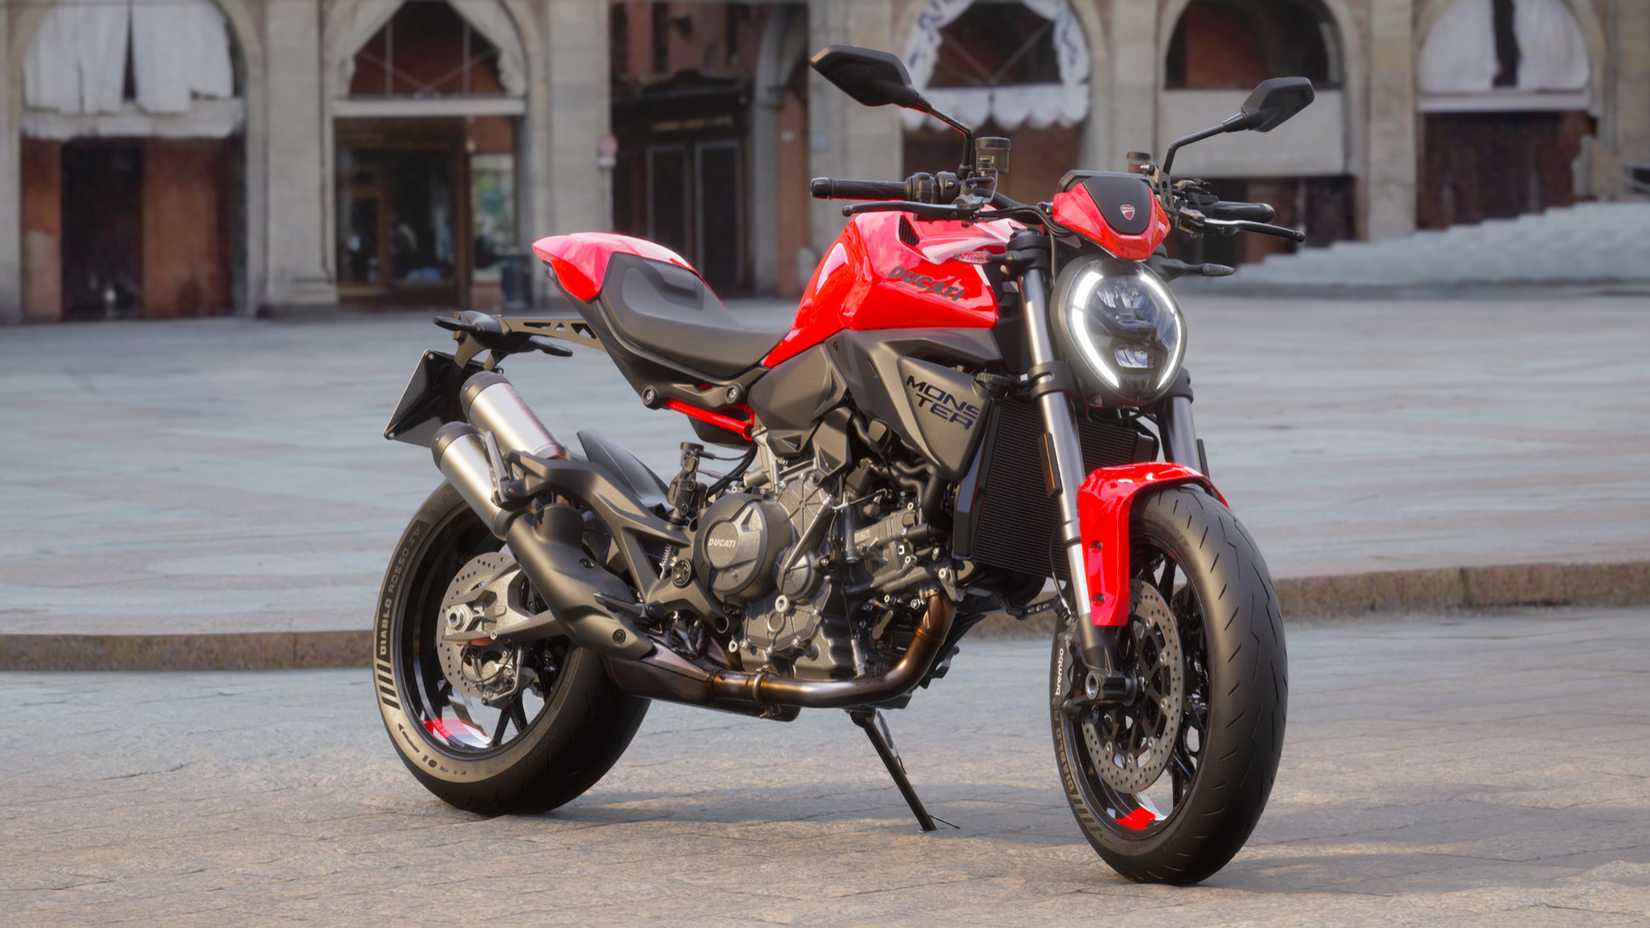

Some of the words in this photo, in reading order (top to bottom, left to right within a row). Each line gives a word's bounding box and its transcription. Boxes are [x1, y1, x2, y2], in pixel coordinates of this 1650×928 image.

[888, 265, 964, 301] DUCATI
[906, 375, 980, 419] MONS
[916, 393, 974, 430] TER
[708, 538, 736, 549] DUCATI
[379, 598, 392, 656] DIABLO
[1055, 647, 1064, 696] brembo
